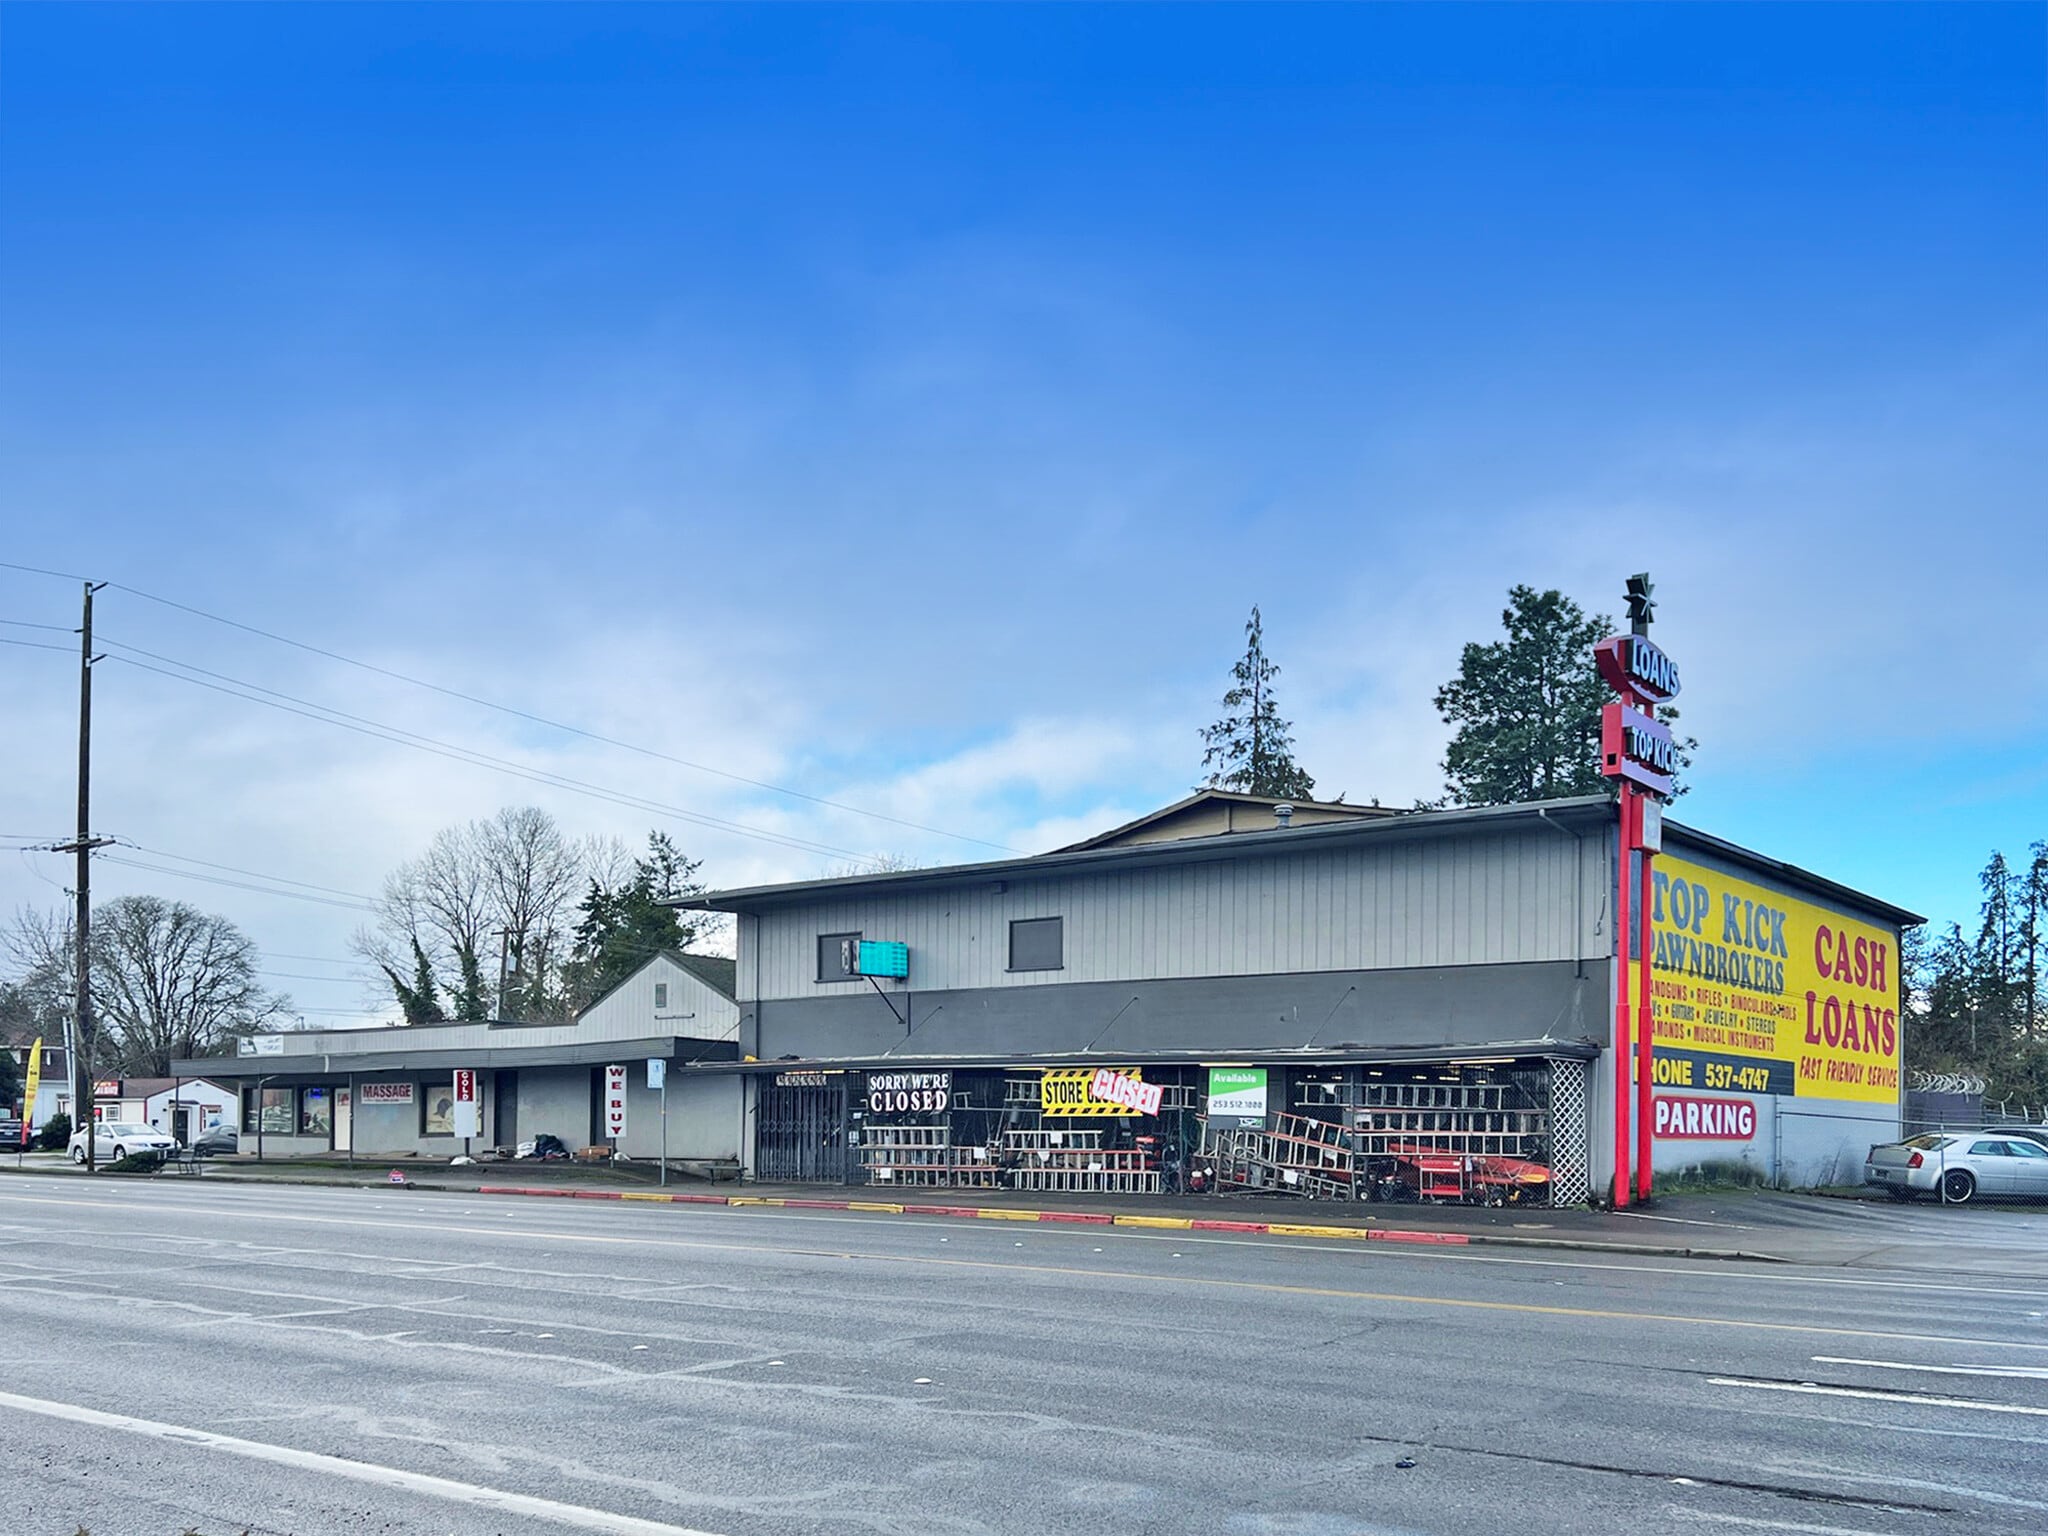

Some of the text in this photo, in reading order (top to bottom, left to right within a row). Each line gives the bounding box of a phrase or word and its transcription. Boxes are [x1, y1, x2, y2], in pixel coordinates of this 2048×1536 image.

[1632, 640, 1679, 696] LOANS
[1632, 726, 1653, 761] TOP
[1652, 870, 1788, 959] TOP KICK
[1815, 924, 1886, 993] CASH
[1697, 987, 1722, 1008] RIFLES
[1731, 993, 1773, 1017] BINOCULARS
[1703, 1008, 1738, 1029] JEWELRY
[1746, 1016, 1776, 1035] STEREOS
[1805, 991, 1895, 1057] LOANS
[1694, 1026, 1726, 1045] MUSICAL
[1728, 1031, 1775, 1052] INSTRUMENTS
[870, 1073, 949, 1091] SORRY WE'RE
[1213, 1073, 1257, 1084] Available
[1705, 1062, 1770, 1092] 537-4747
[1800, 1055, 1898, 1088] FAST FRIENDLY SERVICE
[363, 1085, 412, 1098] MASSAGE
[609, 1068, 625, 1134] WE BUY
[870, 1091, 947, 1113] CLOSED
[1045, 1080, 1083, 1104] STORE
[1092, 1068, 1160, 1116] CLOSED
[1656, 1101, 1752, 1136] PARKING
